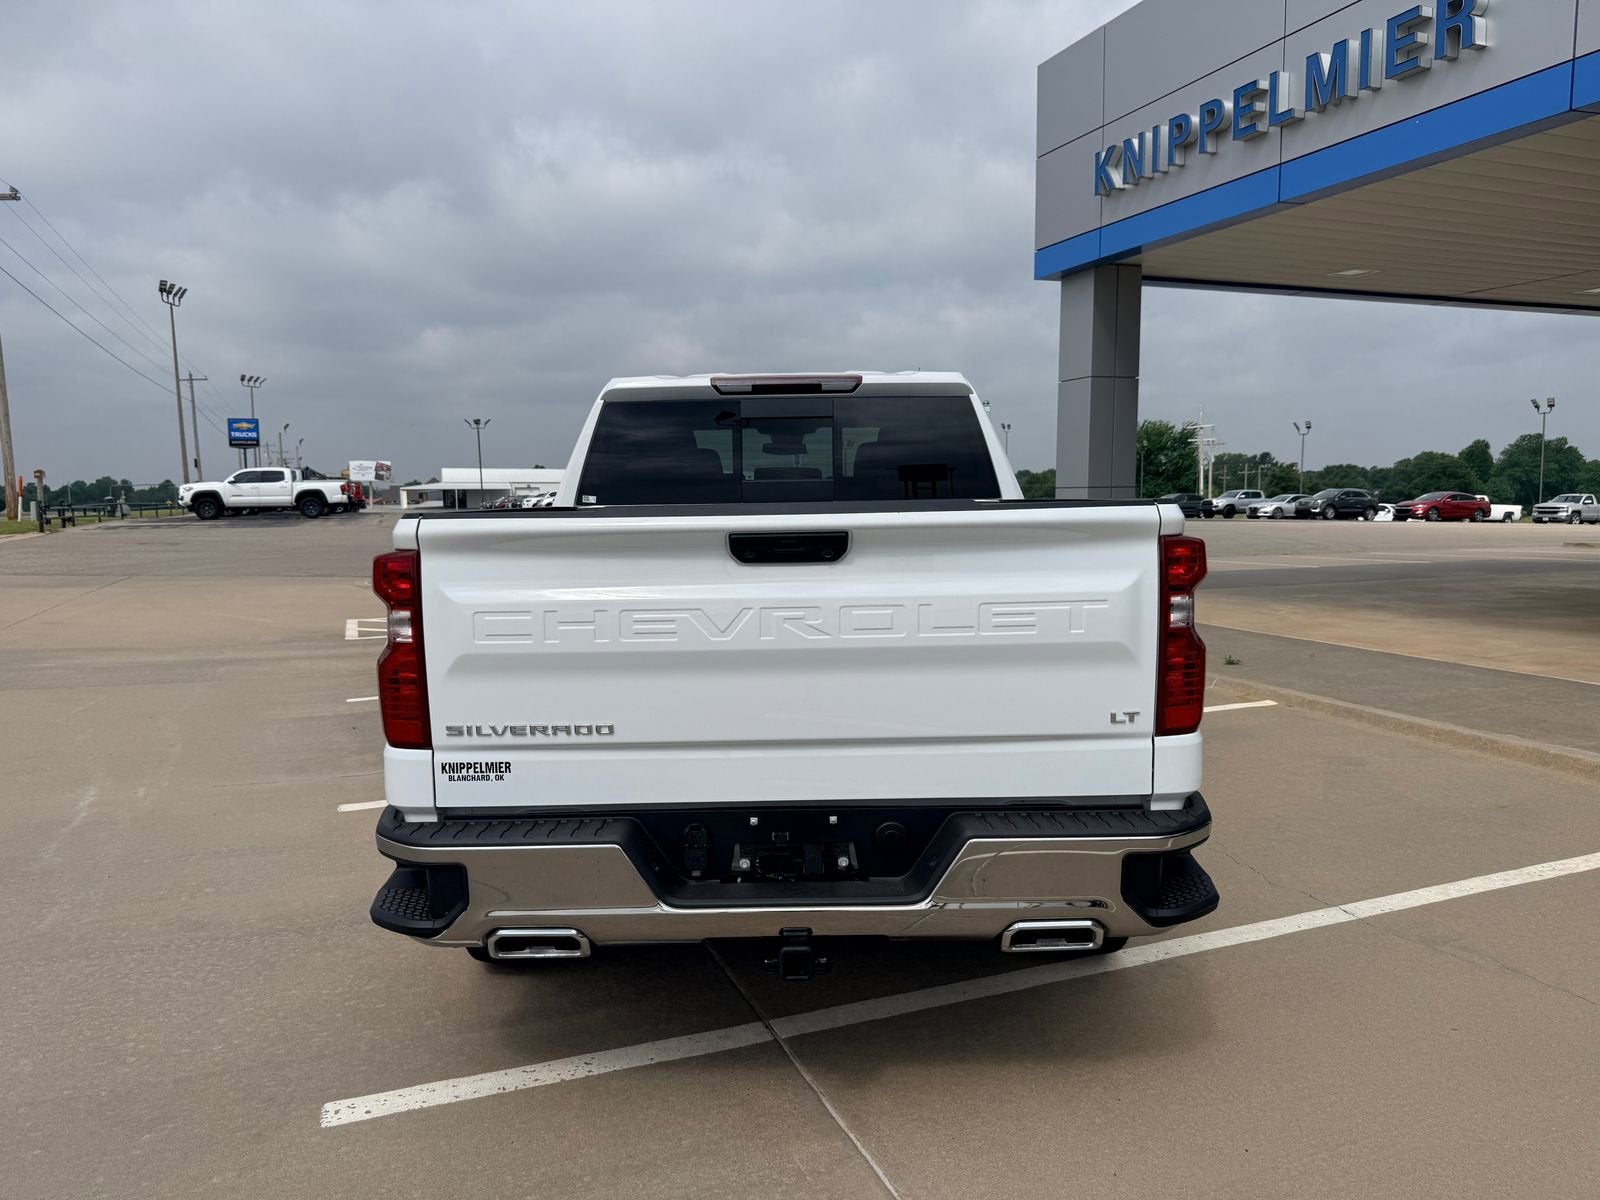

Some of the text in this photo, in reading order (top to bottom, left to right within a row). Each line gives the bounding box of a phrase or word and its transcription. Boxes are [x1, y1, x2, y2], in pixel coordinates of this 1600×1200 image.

[1094, 0, 1488, 197] KNIPPELMIER
[472, 599, 1109, 645] CHEVROLET
[1110, 711, 1140, 724] LT
[445, 724, 615, 737] SILVERADO
[441, 761, 512, 775] KNIPPELMIER
[448, 774, 505, 782] BLANCHARD, OK
